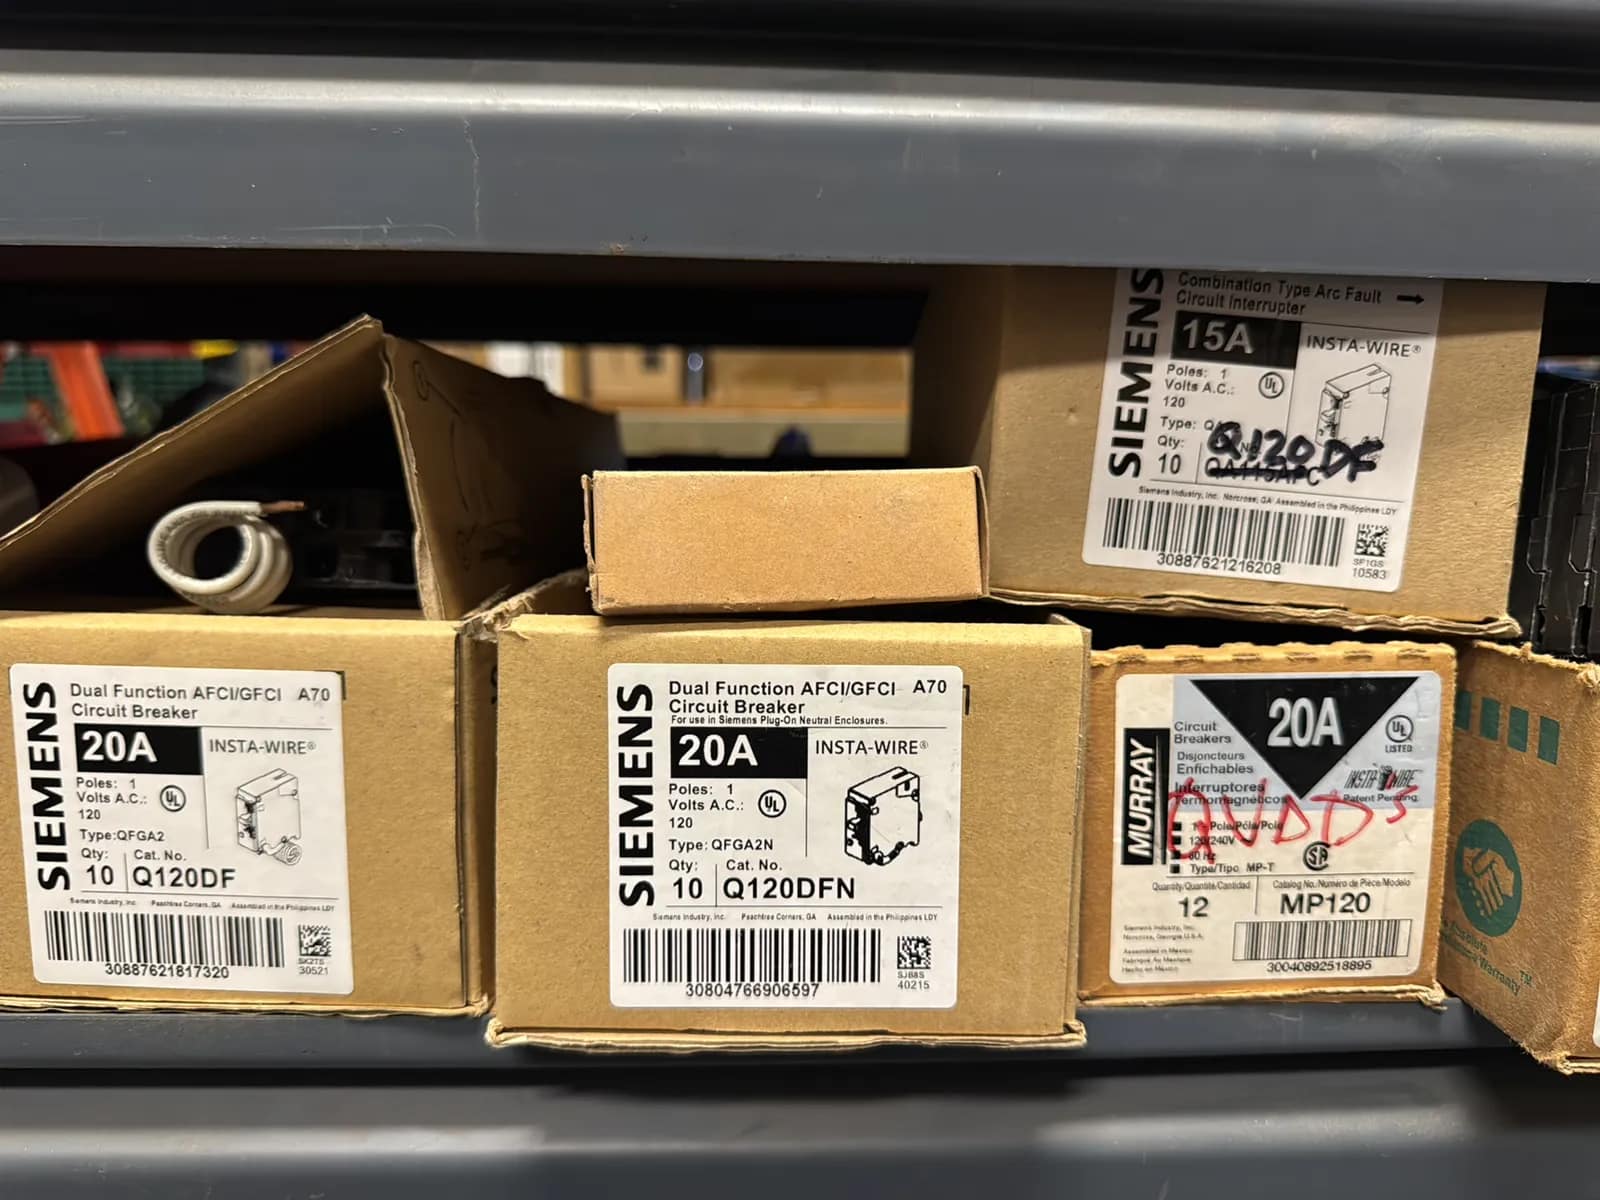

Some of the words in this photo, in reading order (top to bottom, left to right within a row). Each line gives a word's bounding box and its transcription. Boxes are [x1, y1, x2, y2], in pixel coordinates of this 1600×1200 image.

[1178, 272, 1272, 294] Combination
[1278, 281, 1311, 298] Type
[1314, 284, 1341, 300] Arc
[1345, 286, 1382, 305] Fault
[1176, 289, 1225, 308] Circuit
[1229, 295, 1306, 316] Interrupter
[1182, 318, 1254, 355] 15A
[1108, 268, 1164, 478] SIEMENS
[1166, 364, 1208, 378] Poles:
[1220, 368, 1227, 379] 1
[1165, 378, 1198, 392] Volts
[1163, 396, 1185, 408] 120
[1160, 415, 1197, 431] Type:
[1157, 434, 1185, 450] Qty:
[1158, 453, 1182, 475] 10
[1138, 486, 1170, 496] Siemens
[1171, 488, 1204, 500] Industry,
[1260, 496, 1272, 505] GA
[1275, 497, 1316, 508] Assembled
[1326, 502, 1338, 510] the
[1339, 503, 1380, 514] Philippines
[1156, 552, 1281, 575] 30887621216208
[1353, 567, 1386, 580] 10583
[70, 683, 107, 698] Dual
[113, 684, 187, 700] Function
[193, 686, 282, 702] AFCI/GFCI
[298, 687, 331, 702] A70
[669, 680, 709, 696] Dual
[715, 681, 794, 696] Function
[800, 681, 896, 697] AFCI/GFCI
[913, 679, 947, 694] A70
[71, 702, 127, 718] Circuit
[132, 703, 198, 720] Breaker
[668, 699, 729, 714] Circuit
[735, 699, 805, 714] Breaker
[671, 715, 688, 725] For
[689, 716, 705, 725] use
[708, 715, 716, 725] in
[718, 715, 757, 725] Siemens
[760, 715, 797, 727] Plug-On
[799, 715, 832, 726] Neutral
[834, 715, 888, 726] Enclosures.
[1174, 721, 1217, 732] Circuit
[1267, 697, 1344, 747] 20A
[1174, 733, 1232, 744] Breakers
[81, 730, 158, 763] 20A
[678, 733, 759, 767] 20A
[1385, 745, 1413, 753] LISTED
[1177, 751, 1245, 762] Disjoncteurs
[1177, 763, 1254, 775] Enfichables
[24, 682, 71, 890] SIEMENS
[76, 777, 118, 789] Poles:
[129, 778, 136, 789] 1
[668, 783, 713, 795] Poles:
[727, 783, 733, 795] 1
[1174, 781, 1265, 794] Interruptores
[77, 791, 111, 803] Volts
[617, 683, 655, 906] SIEMENS
[1128, 737, 1154, 857] MURRAY
[1343, 794, 1375, 802] Patent
[668, 799, 705, 811] Volts
[79, 808, 101, 820] 120
[669, 817, 693, 829] 120
[668, 839, 708, 853] Type:
[711, 838, 774, 851] QFGA2N
[81, 847, 109, 862] Qty:
[134, 850, 160, 861] Cat.
[164, 850, 187, 861] No.
[669, 859, 699, 873] Qty:
[726, 859, 754, 871] Cat.
[759, 859, 783, 871] No.
[1246, 862, 1275, 872] MP-T
[86, 864, 114, 886] 10
[132, 866, 236, 888] Q120DF
[672, 877, 703, 899] 10
[723, 877, 855, 900] Q120DFN
[1272, 880, 1302, 890] Catalog
[1178, 896, 1209, 917] 12
[1280, 892, 1371, 914] MP120
[653, 913, 680, 921] Siemens
[741, 912, 774, 921] Peachtree
[806, 912, 817, 921] GA
[827, 912, 864, 921] Assembled
[865, 912, 873, 921] in
[873, 912, 884, 921] the
[885, 912, 922, 923] Philippines
[923, 912, 938, 921] LDY
[105, 963, 229, 979] 30887621817320
[298, 966, 329, 975] 30521
[1266, 960, 1372, 973] 30040892518895
[686, 983, 820, 997] 30804766906597
[897, 980, 930, 990] 40215
